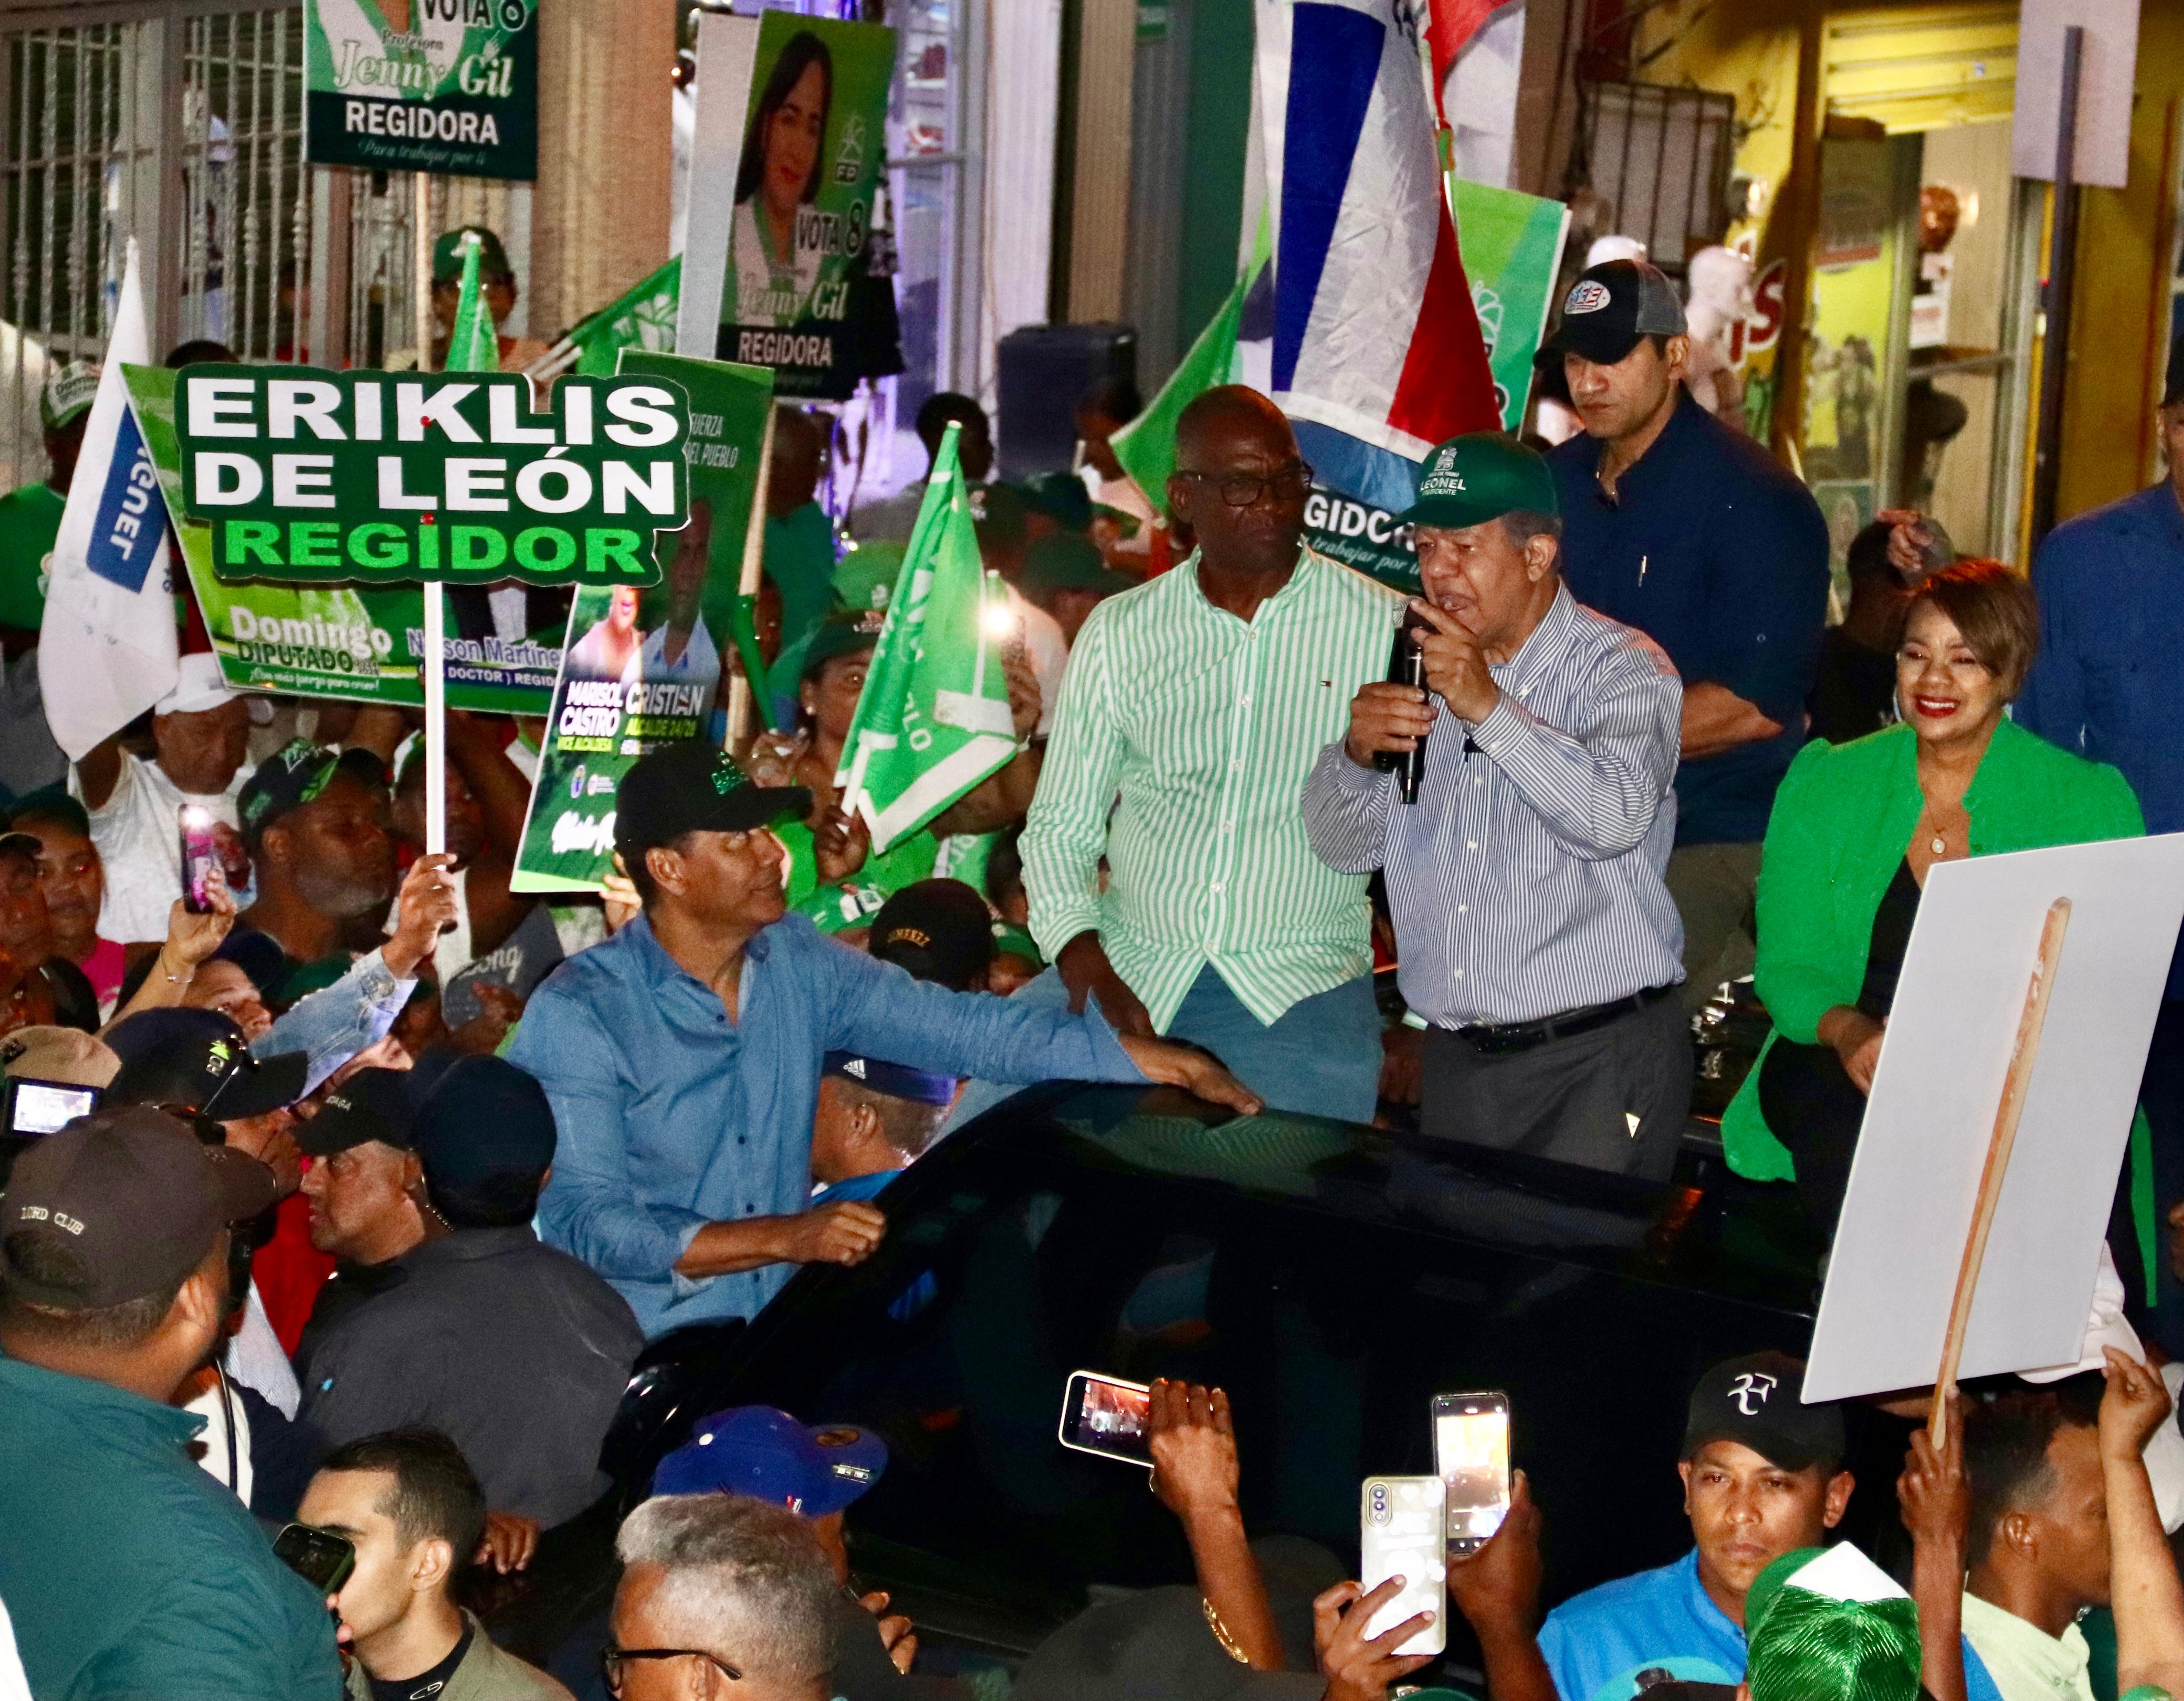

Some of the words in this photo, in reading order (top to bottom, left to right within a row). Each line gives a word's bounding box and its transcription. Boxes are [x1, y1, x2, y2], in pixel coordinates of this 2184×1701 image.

[333, 39, 446, 101] Jenny
[459, 54, 514, 98] Gil
[345, 101, 500, 145] REGIDORA
[796, 212, 840, 252] VOTA
[846, 199, 865, 257] 8
[738, 331, 833, 367] REGIDORA
[187, 377, 679, 447] ERIKLIS
[701, 443, 739, 468] PUEBLO
[195, 451, 337, 508] DE
[377, 446, 675, 515] LEÓN
[1420, 476, 1466, 491] LEONEL
[225, 519, 645, 572] REGIDOR
[1312, 536, 1378, 564] trabajar
[1373, 555, 1408, 572] por
[230, 606, 393, 659] Domingo
[406, 628, 484, 662] Nson
[237, 641, 353, 673] DIPUTADO
[448, 666, 503, 682] DOCTOR
[514, 673, 558, 686] REGID
[565, 681, 624, 708] MARISOL
[625, 682, 705, 716] CRISTIAN
[559, 706, 621, 737] CASTRO
[20, 1206, 49, 1220] LORD
[54, 1212, 85, 1235] CLUB
